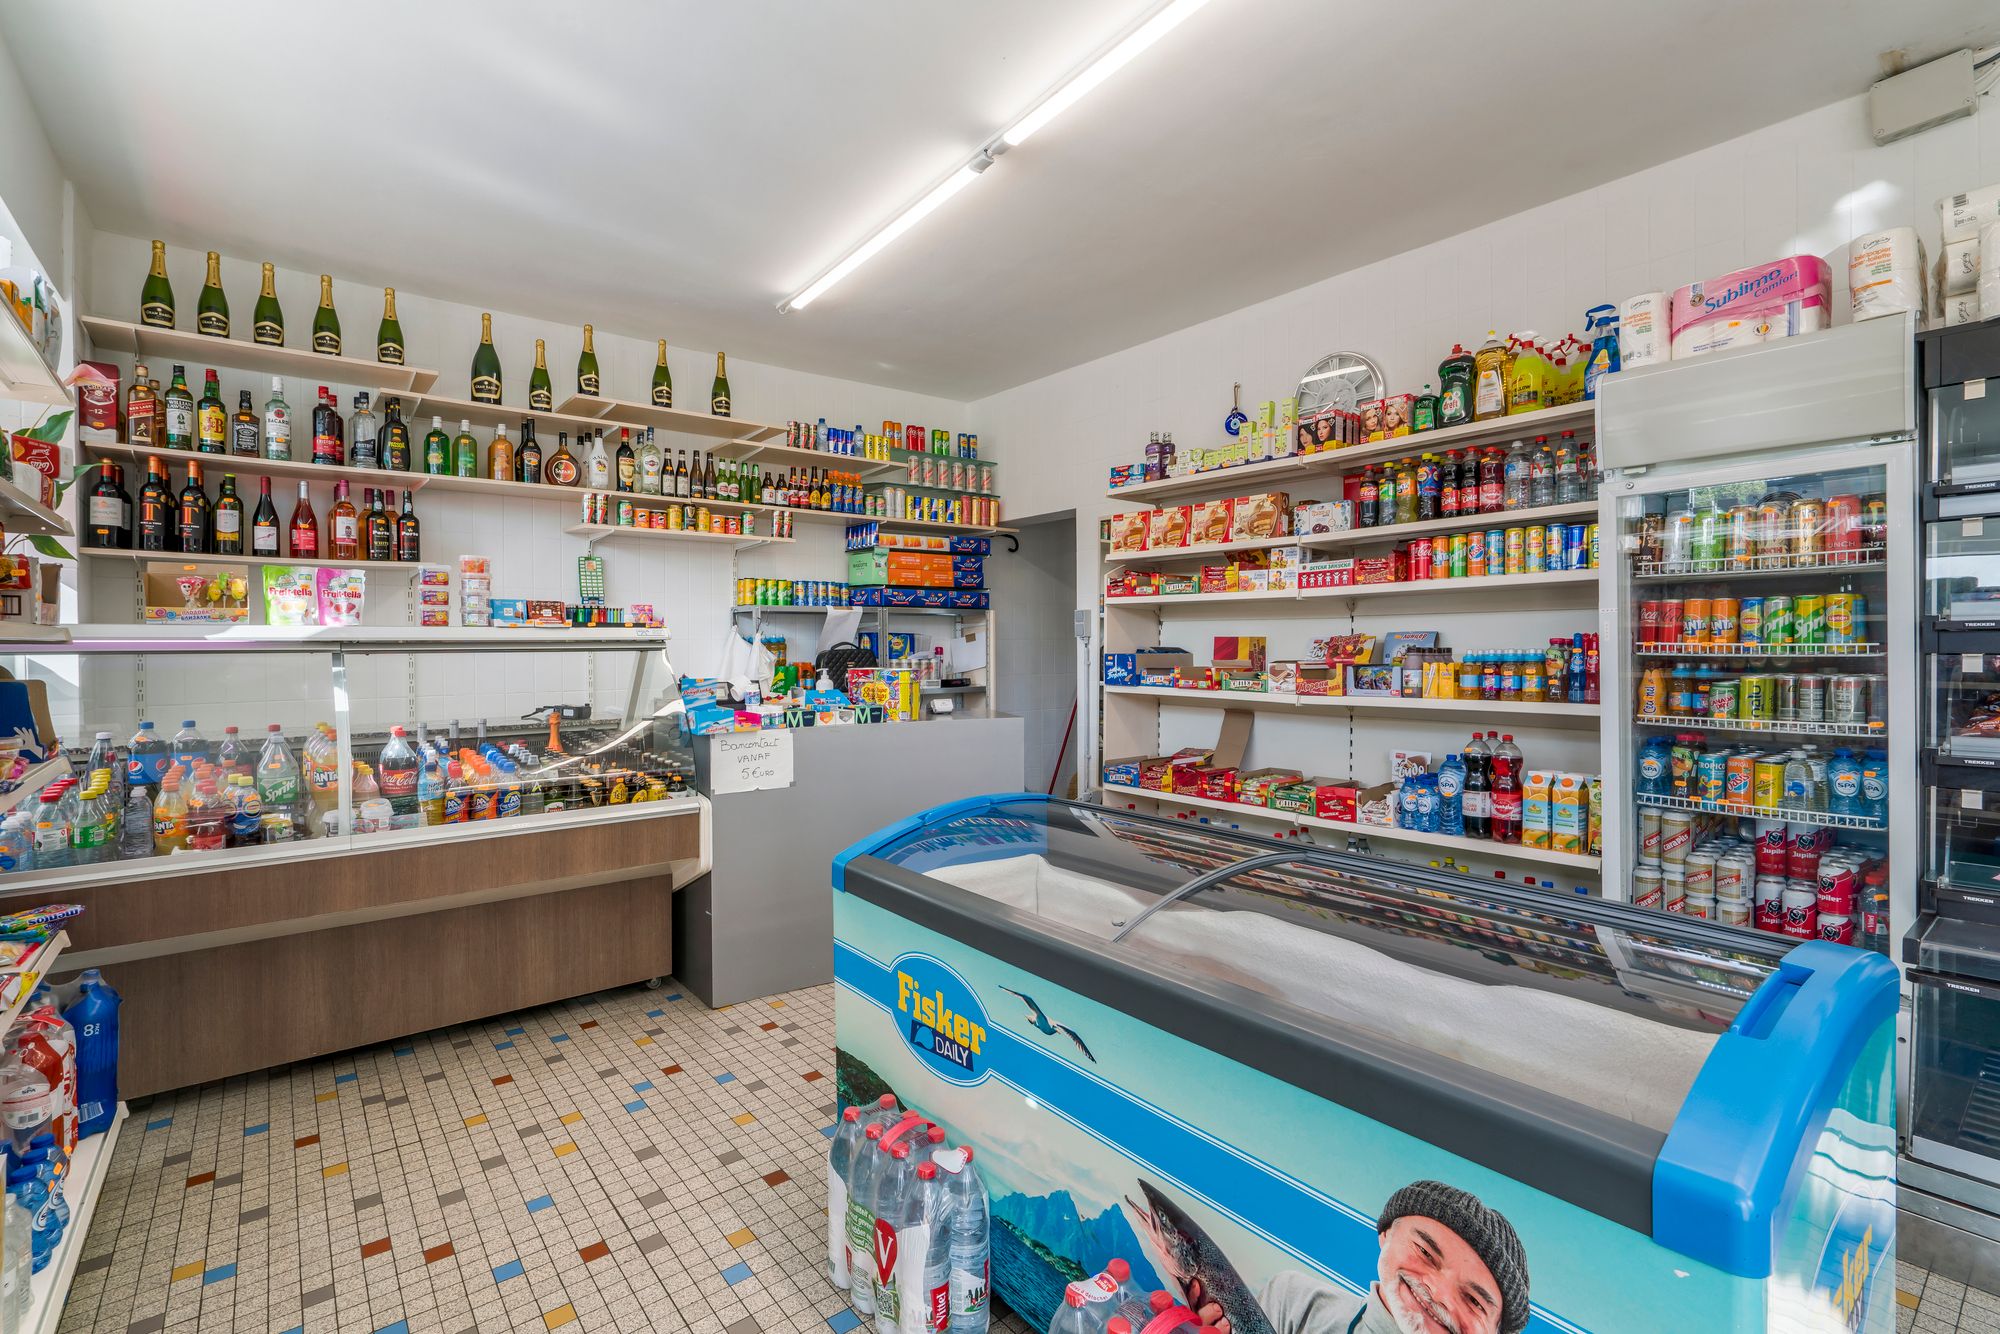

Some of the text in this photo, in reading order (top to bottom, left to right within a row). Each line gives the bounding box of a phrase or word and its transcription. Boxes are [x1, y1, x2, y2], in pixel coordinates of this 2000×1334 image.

[1705, 269, 1781, 314] Sublimo
[720, 737, 780, 752] Bancontact
[737, 752, 771, 763] VANAF
[741, 767, 750, 780] 5
[1643, 765, 1658, 773] SPA
[266, 780, 296, 802] Sprite
[1791, 851, 1818, 859] Jupiler
[1963, 895, 1994, 904] TREKKEN
[28, 908, 81, 926] mentos
[1784, 925, 1812, 935] Jupiler
[1946, 982, 1980, 993] TREKKEN
[898, 970, 986, 1056] Fisker
[83, 1024, 94, 1037] 8
[935, 1036, 969, 1067] DAILY
[876, 1226, 893, 1270] V
[936, 1291, 947, 1326] Vittel
